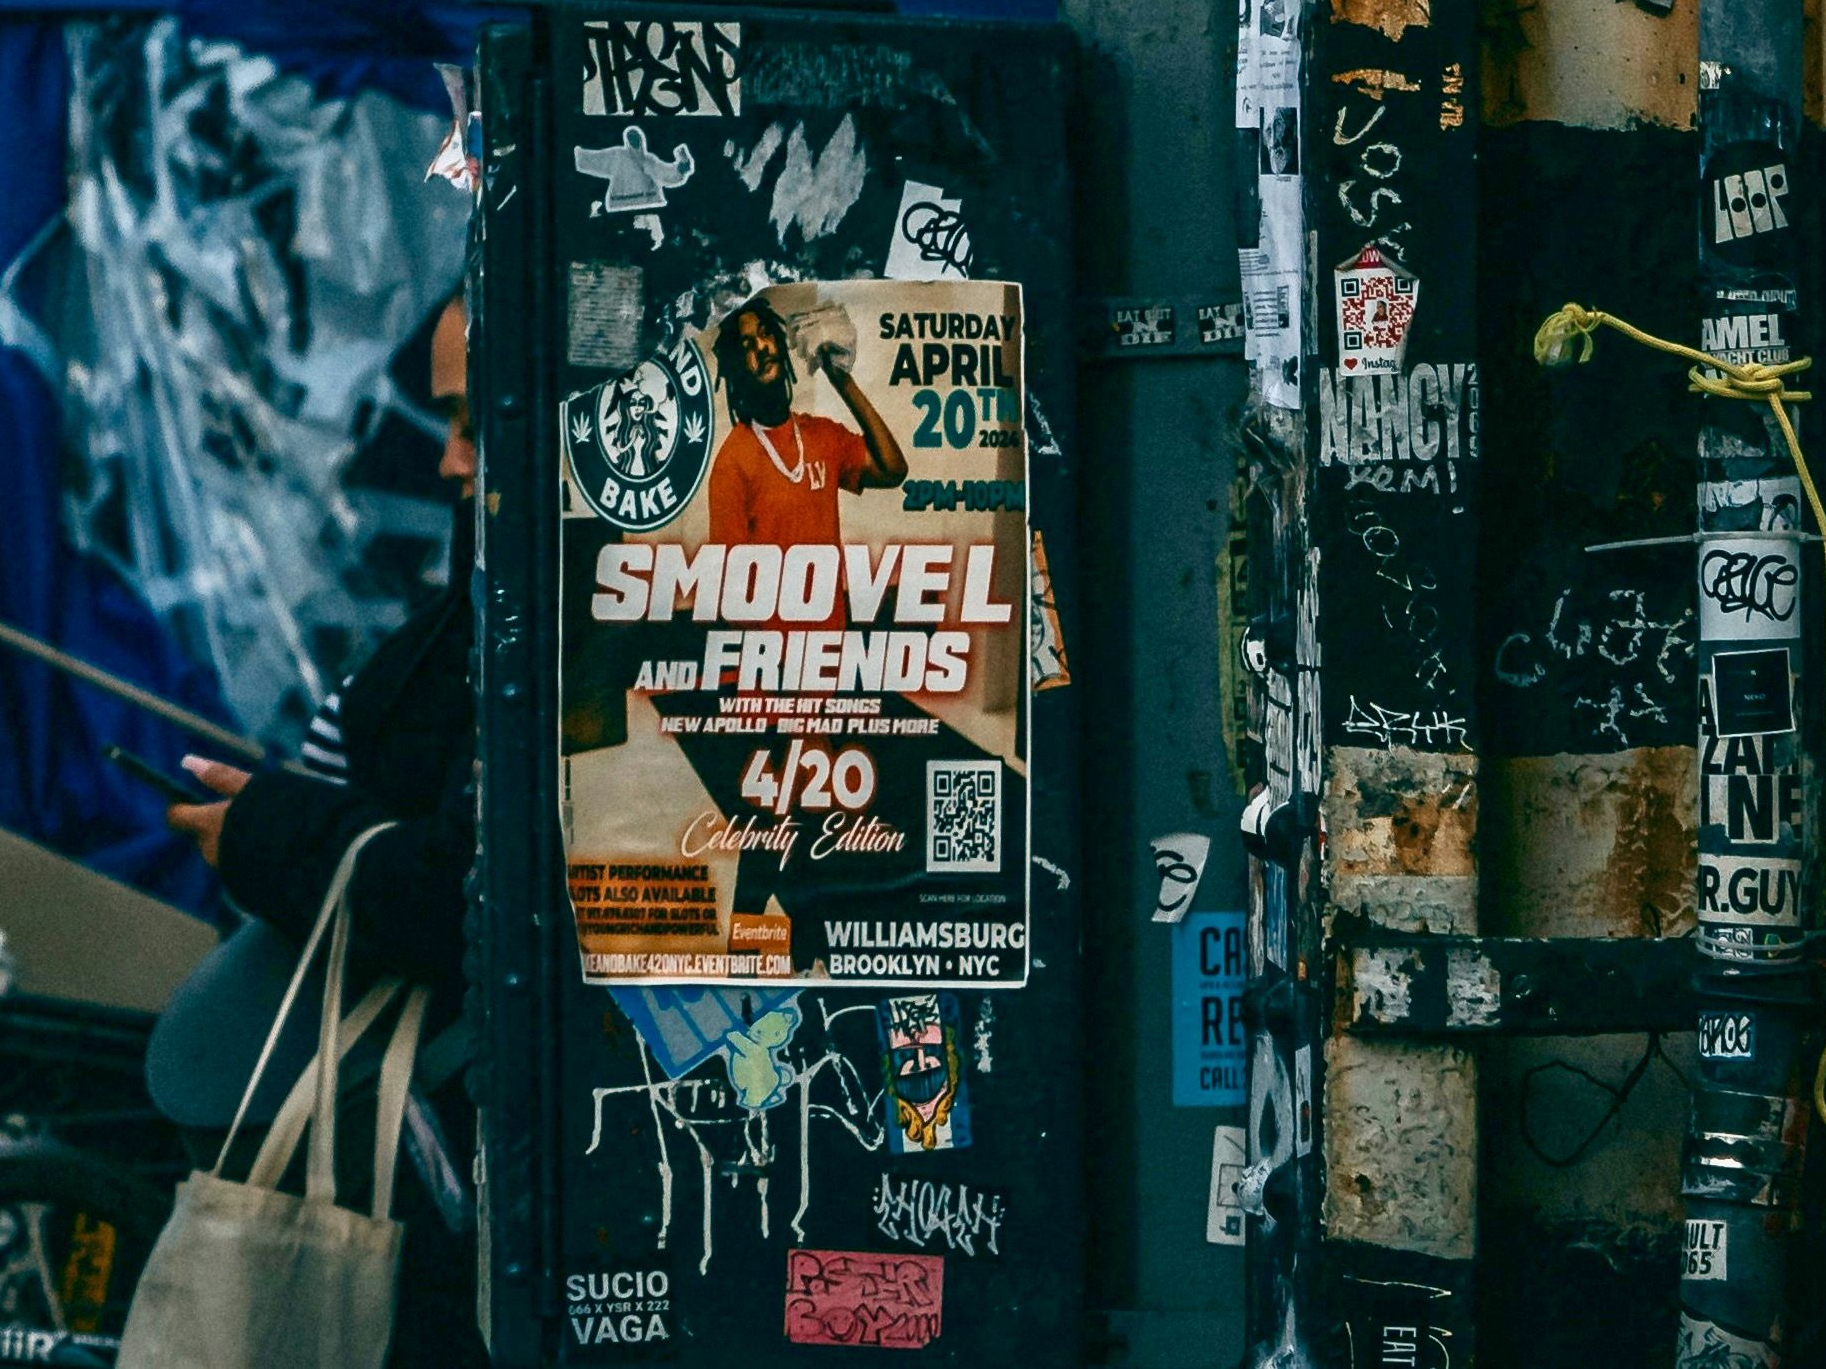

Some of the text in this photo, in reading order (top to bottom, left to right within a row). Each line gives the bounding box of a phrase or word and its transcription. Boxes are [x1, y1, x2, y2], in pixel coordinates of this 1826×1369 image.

[879, 313, 1016, 342] SATURDAY
[668, 338, 702, 397] ND
[888, 342, 1015, 388] APRIL
[1318, 362, 1468, 468] NANCY
[599, 476, 679, 520] BAKE
[590, 543, 1013, 623] SMOOVE L
[633, 629, 971, 693] AND FRIENDS
[718, 697, 882, 714] WITH THE HIT SONGS
[661, 717, 703, 734] NEW
[702, 717, 768, 734] APOLLO
[807, 718, 843, 735] MAD
[847, 718, 890, 735] PLUS
[892, 718, 940, 735] MORE
[740, 738, 876, 816] 4/20
[680, 810, 907, 873] Celebrity Edition
[609, 865, 709, 881] PERFORMANCE
[604, 887, 639, 902] ALSO
[641, 887, 717, 902] AVAILABLE
[732, 922, 788, 941] Eventbrite
[823, 920, 1026, 949] WILLIAMSBURG
[829, 953, 1001, 976] BROOKLYN NYC
[1200, 926, 1247, 977] CA
[1202, 996, 1247, 1046] RE
[1200, 1066, 1240, 1091] CALL
[565, 1270, 670, 1301] SUCIO
[603, 1301, 632, 1313] YSR
[646, 1300, 670, 1313] 222
[570, 1315, 671, 1346] VAGA
[1382, 1326, 1418, 1367] EAT
